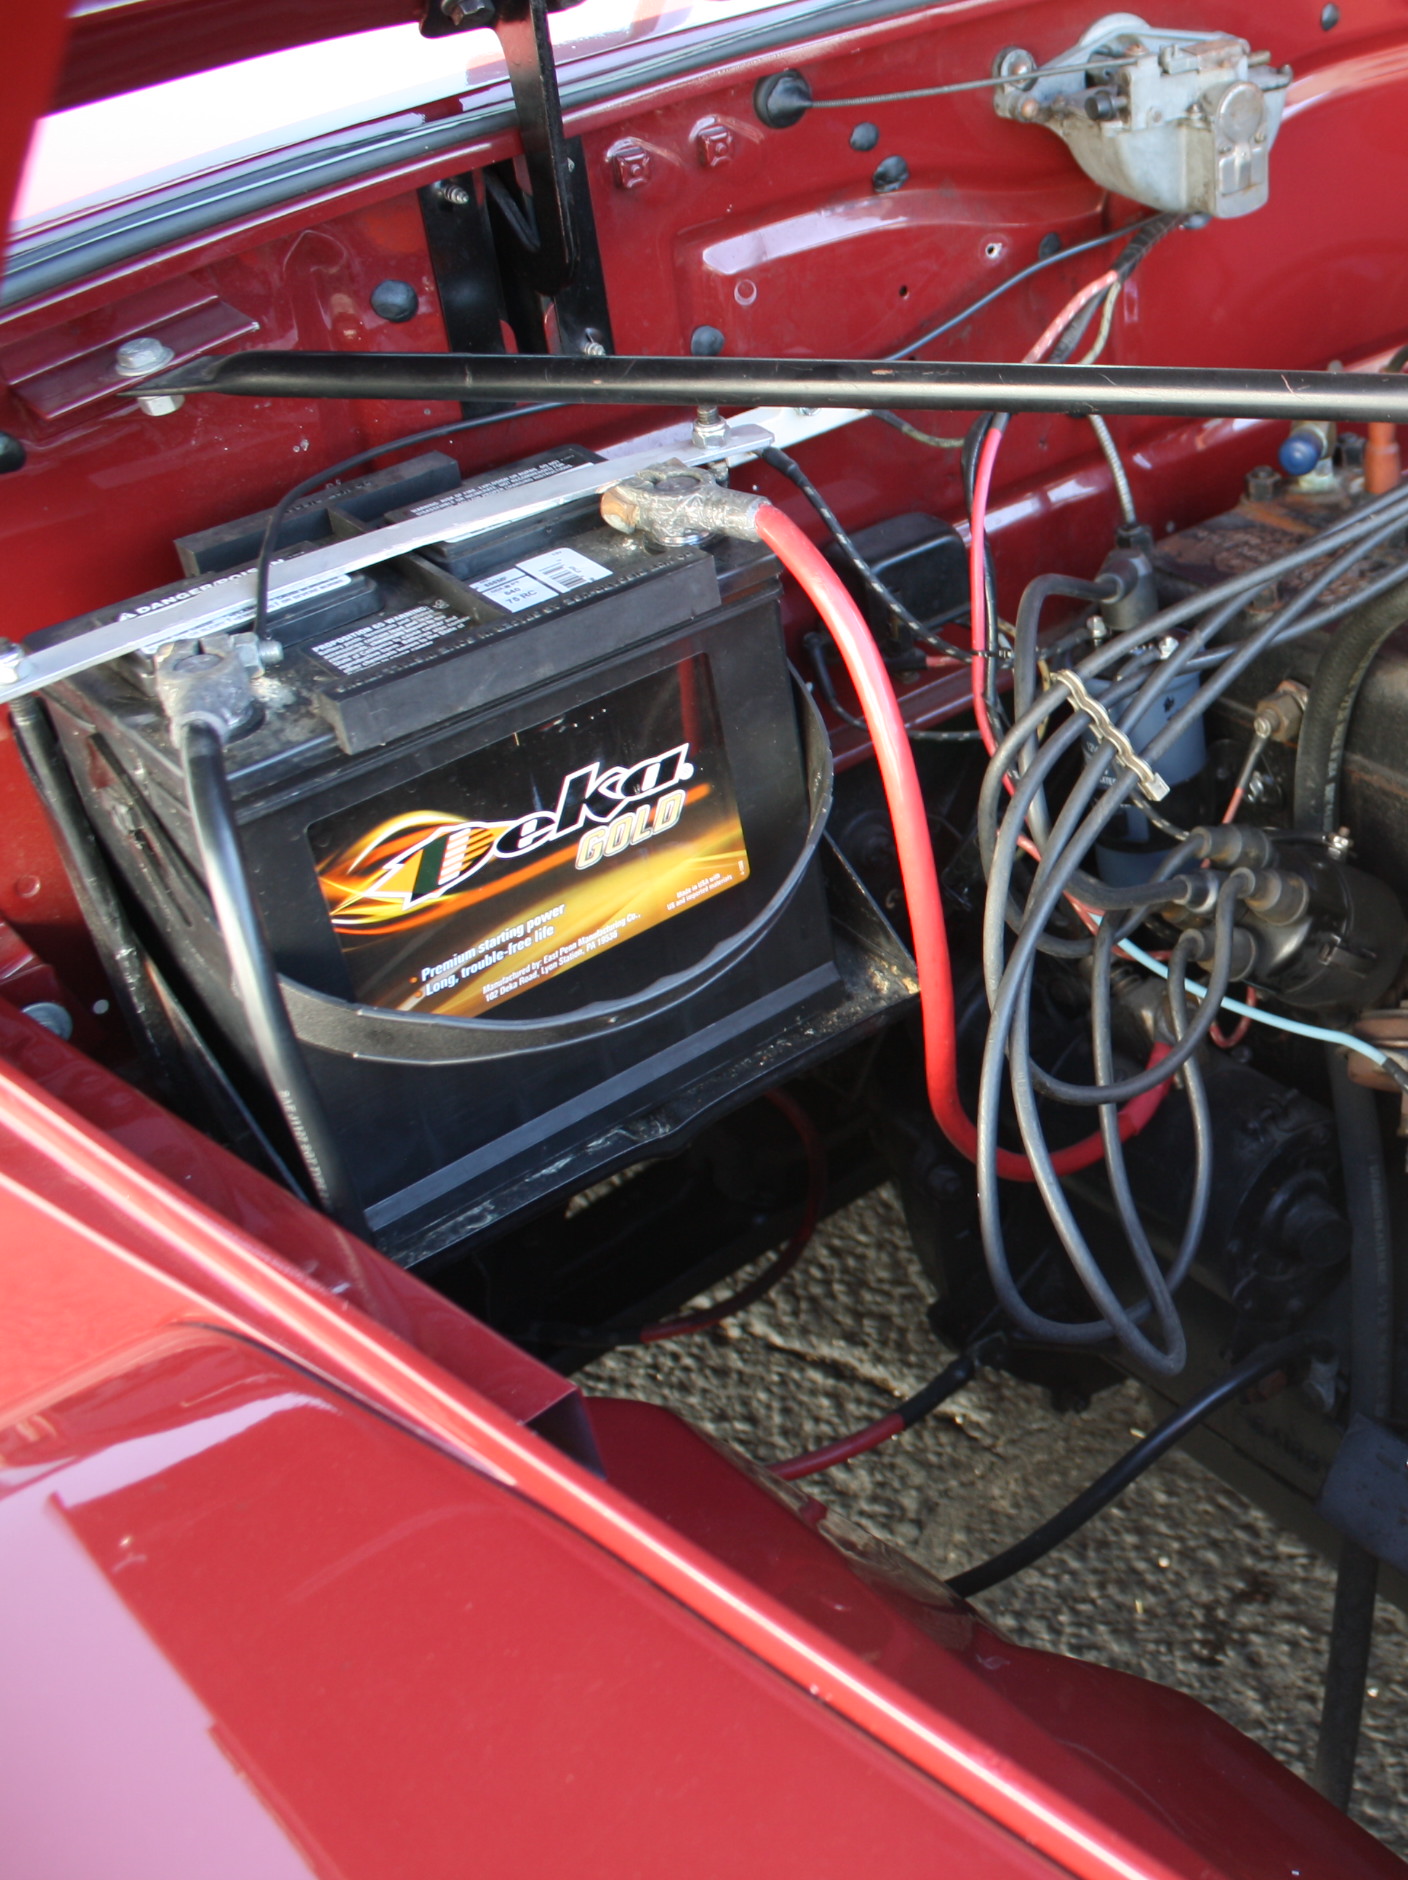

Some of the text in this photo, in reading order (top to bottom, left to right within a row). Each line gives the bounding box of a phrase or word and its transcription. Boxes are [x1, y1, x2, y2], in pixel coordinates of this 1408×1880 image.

[136, 558, 285, 614] DANGER/POISN
[575, 789, 686, 870] GOLD
[421, 904, 565, 982] Premium starting power
[425, 925, 555, 997] Long, trouble-free life
[482, 962, 531, 994] Manufactured
[543, 950, 559, 964] East
[560, 942, 577, 957] Penn
[578, 919, 626, 947] Manufacturing
[500, 981, 518, 996] Deka
[586, 941, 597, 953] PA
